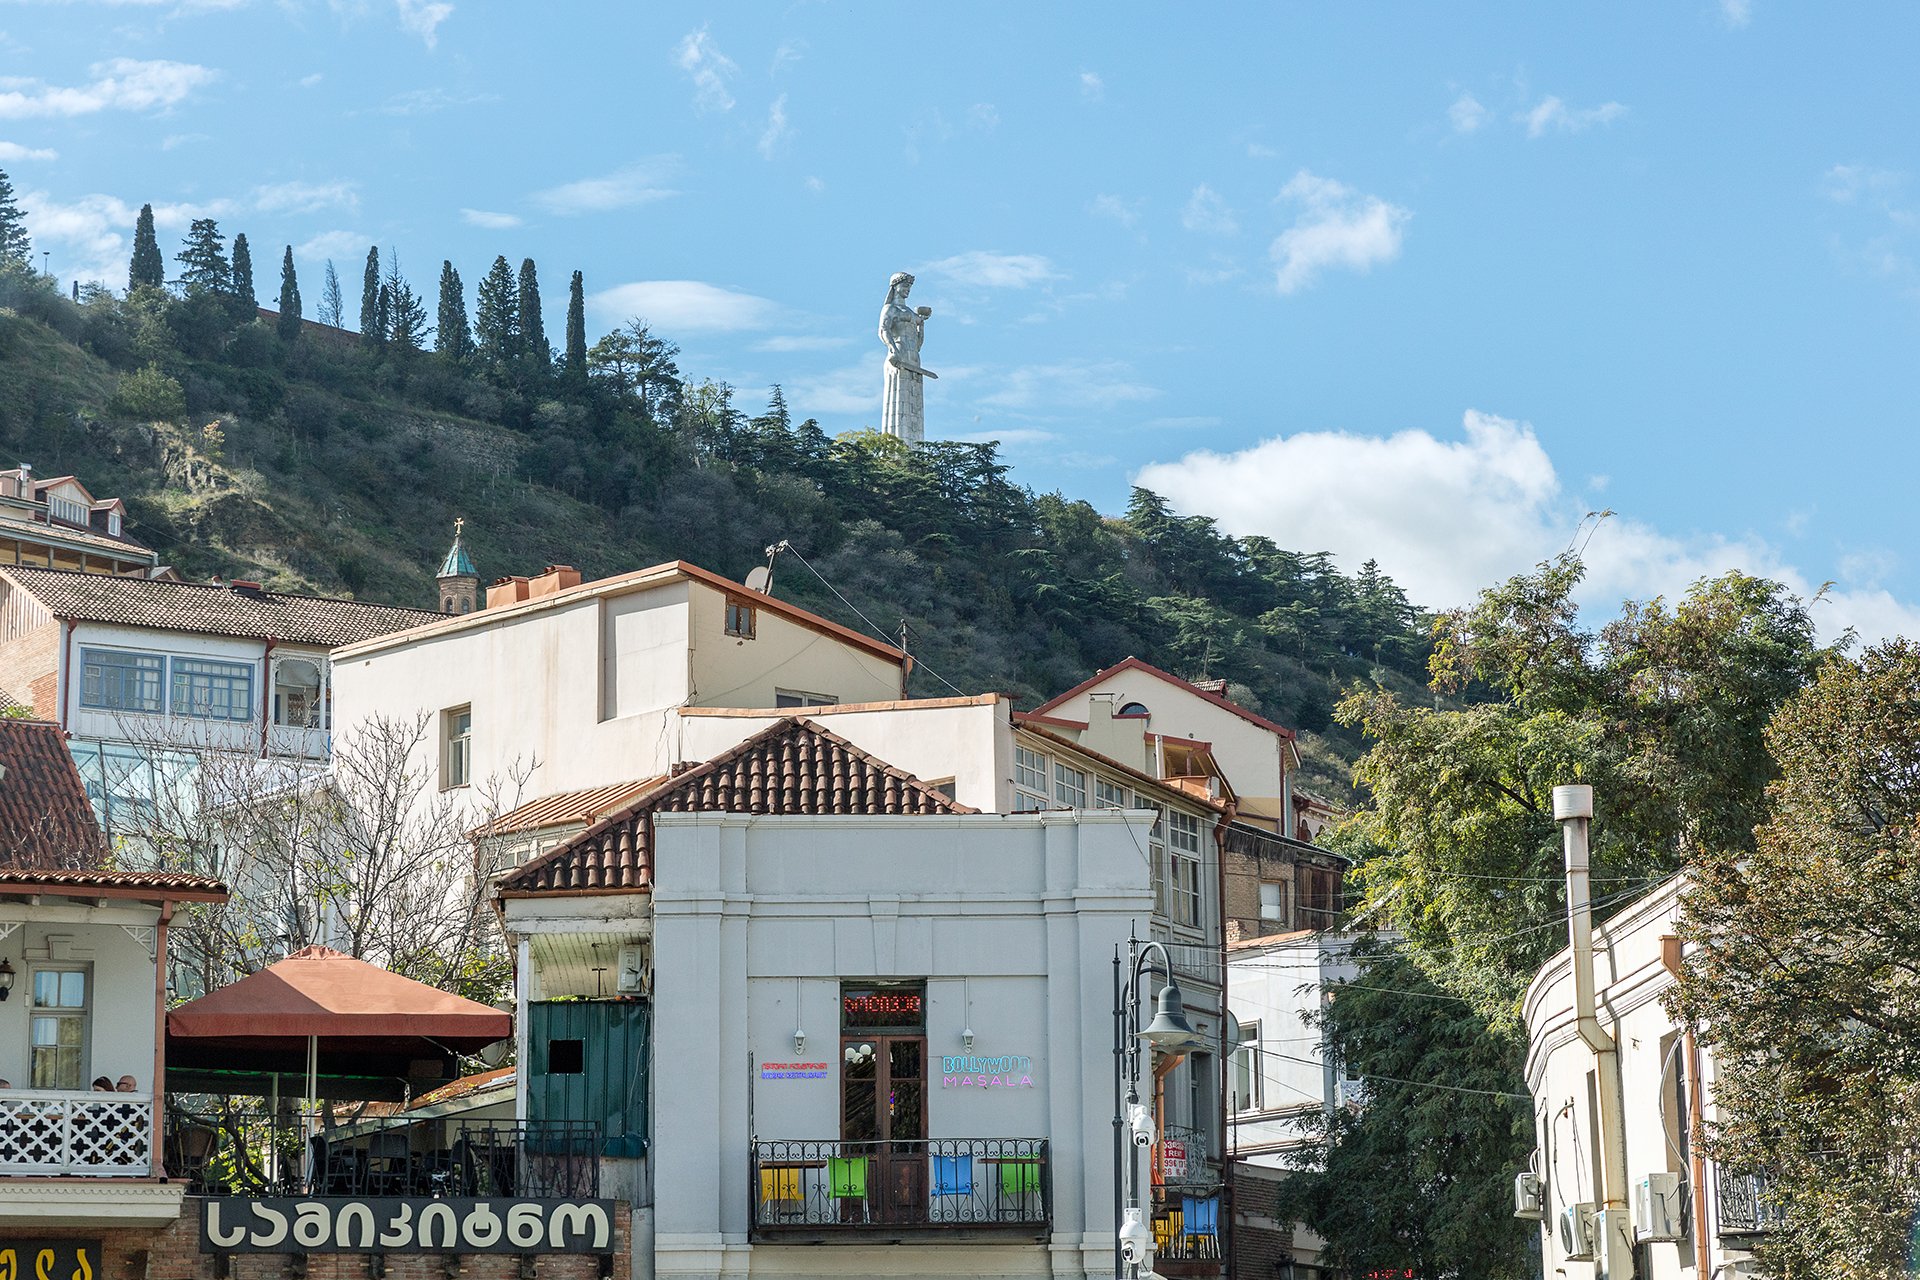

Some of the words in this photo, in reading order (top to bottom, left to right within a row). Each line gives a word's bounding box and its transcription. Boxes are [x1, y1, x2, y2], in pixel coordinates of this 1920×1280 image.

[943, 1055, 1031, 1075] BOLLYWOOD
[943, 1075, 1034, 1087] MASALA
[206, 1201, 610, 1248] სამიკიტნო
